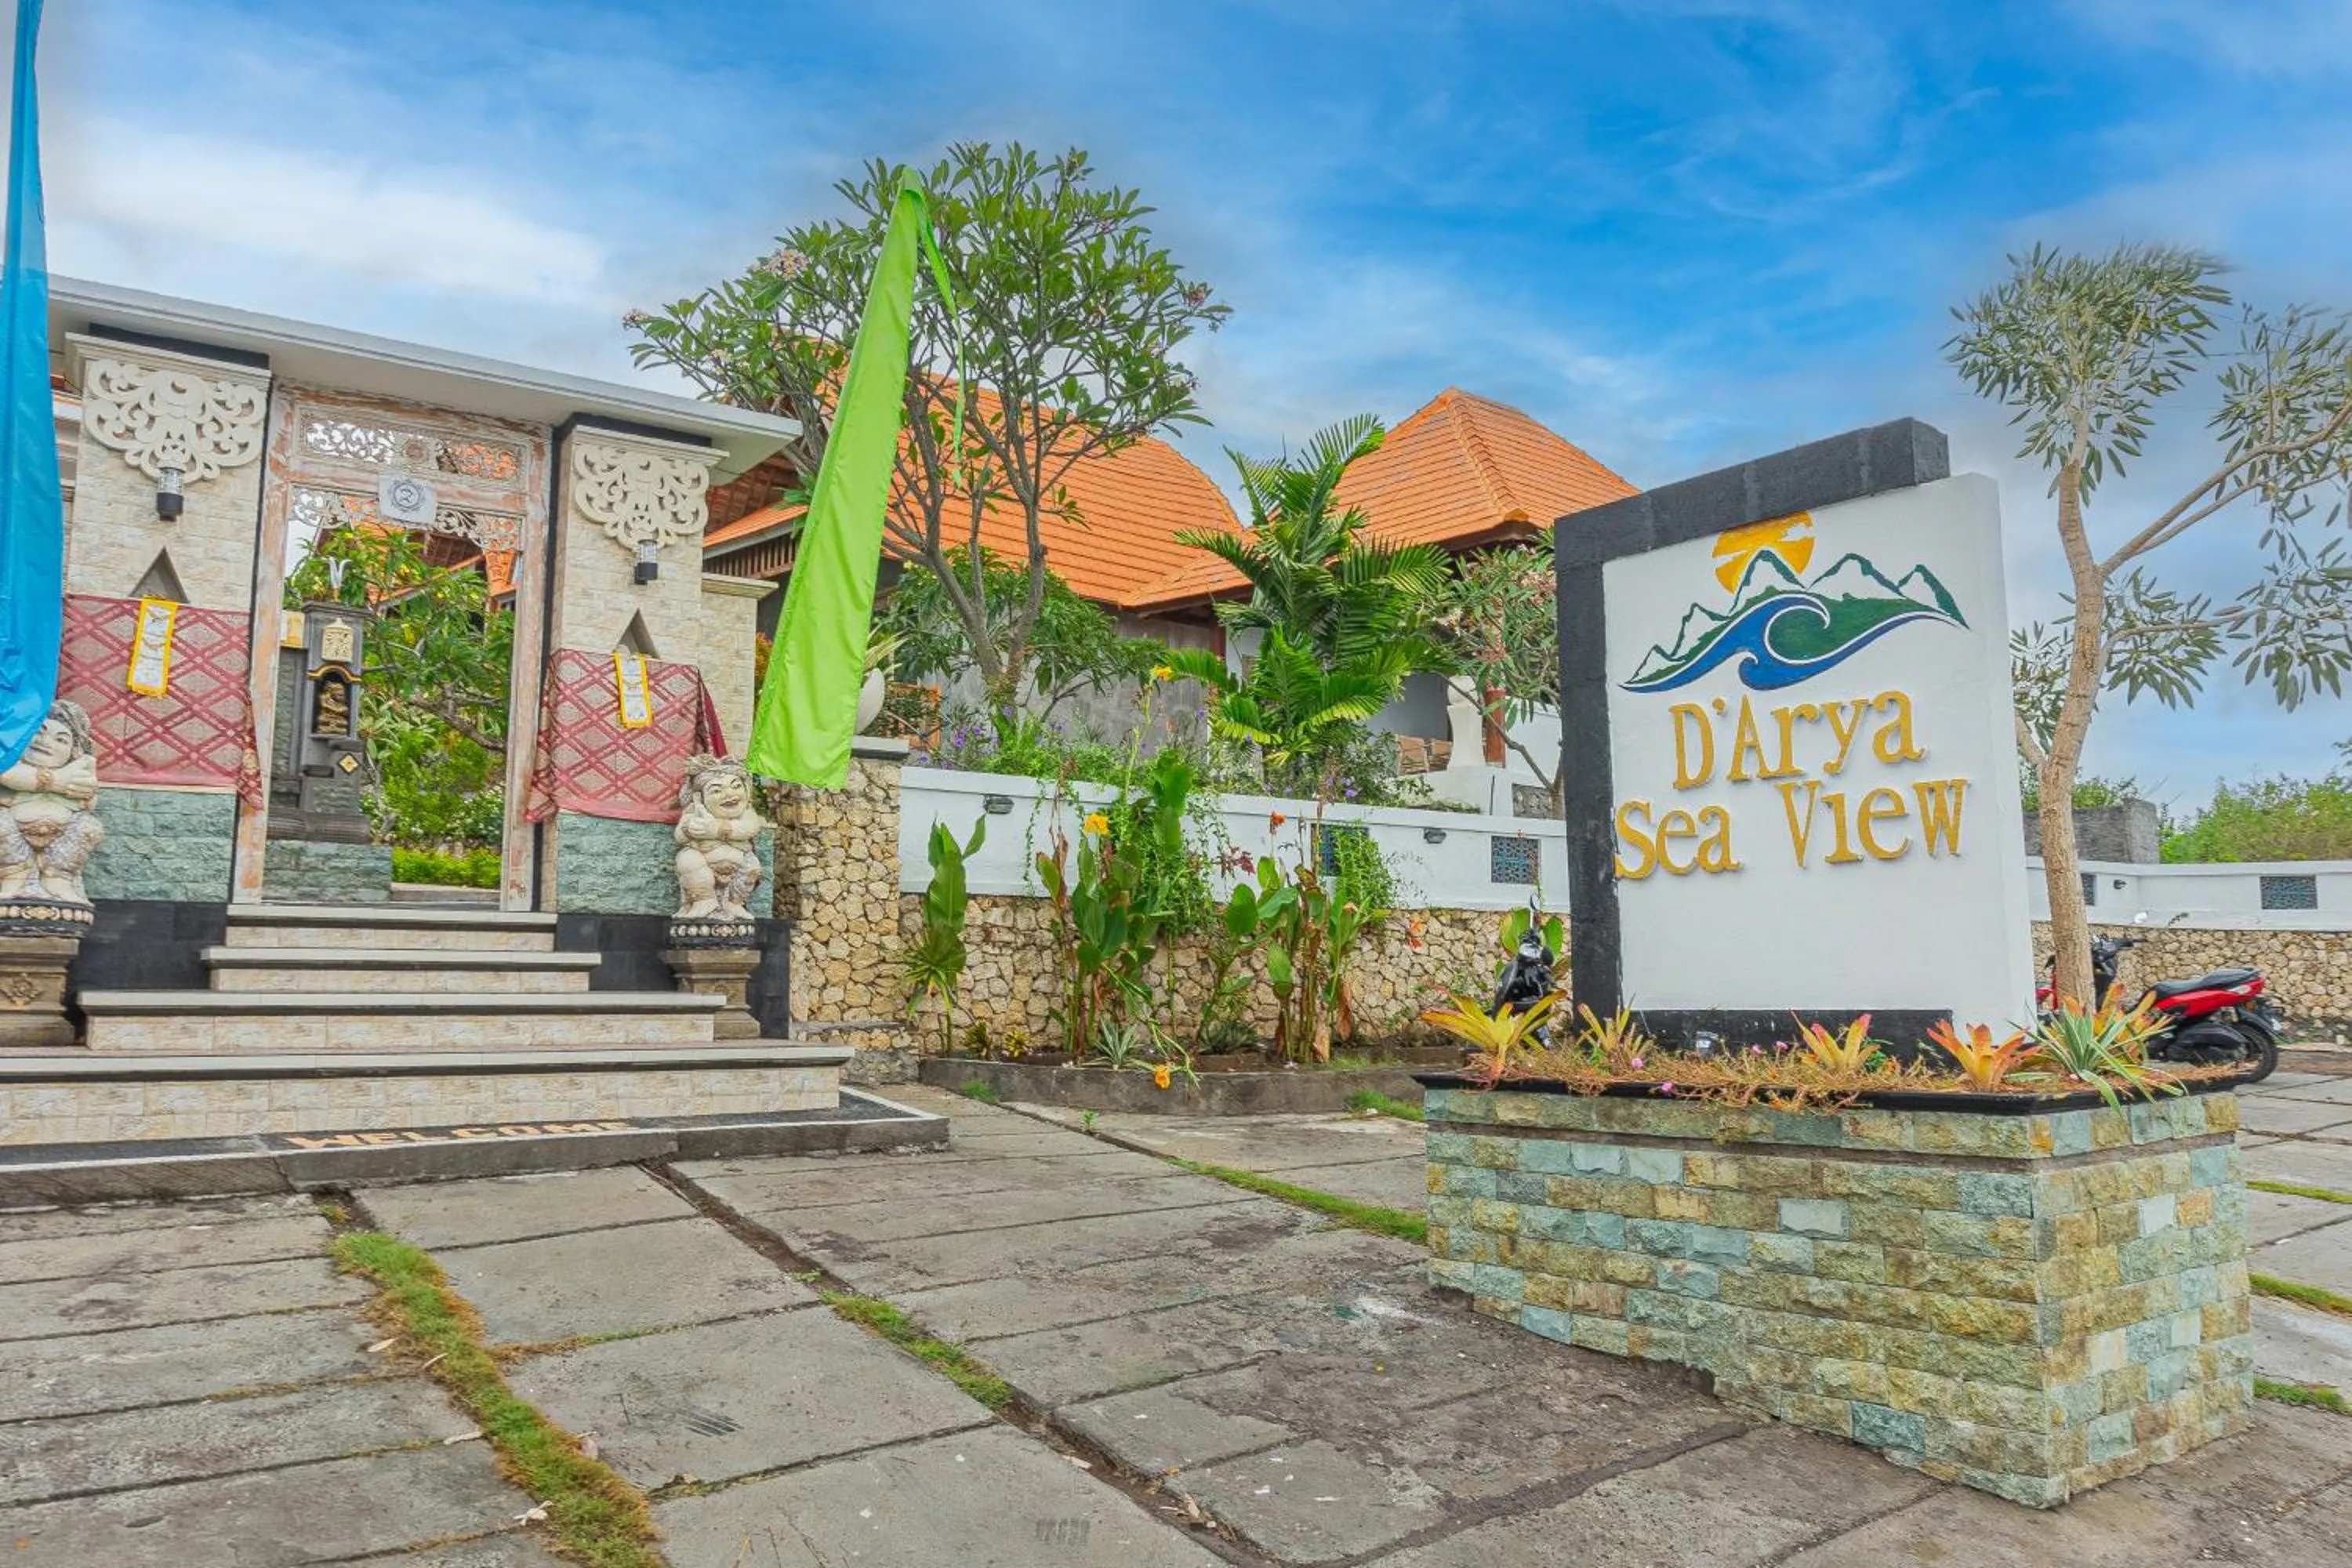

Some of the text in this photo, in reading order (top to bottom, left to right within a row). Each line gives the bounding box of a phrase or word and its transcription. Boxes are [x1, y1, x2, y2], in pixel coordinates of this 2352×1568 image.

[1669, 690, 1926, 789] D'Arya
[1614, 779, 1970, 880] Sea View
[285, 1121, 639, 1149] WELCOME
